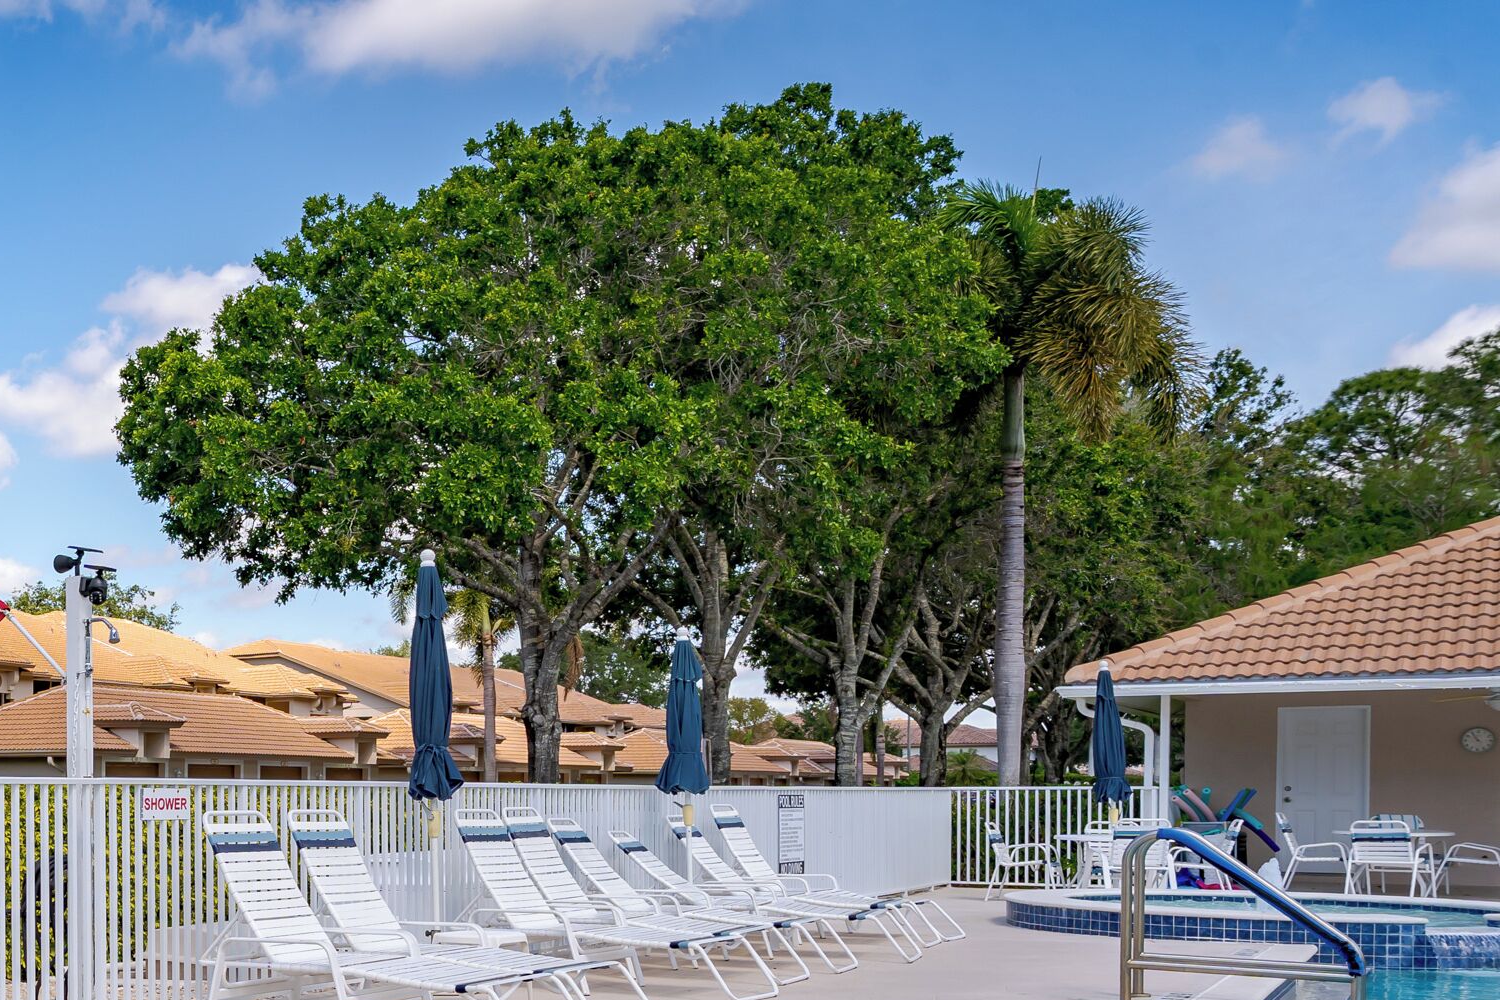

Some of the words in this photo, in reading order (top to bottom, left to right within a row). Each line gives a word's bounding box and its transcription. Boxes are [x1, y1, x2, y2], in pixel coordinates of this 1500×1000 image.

[144, 797, 188, 811] SHOWER
[780, 795, 790, 808] POOL
[791, 795, 804, 808] RULES
